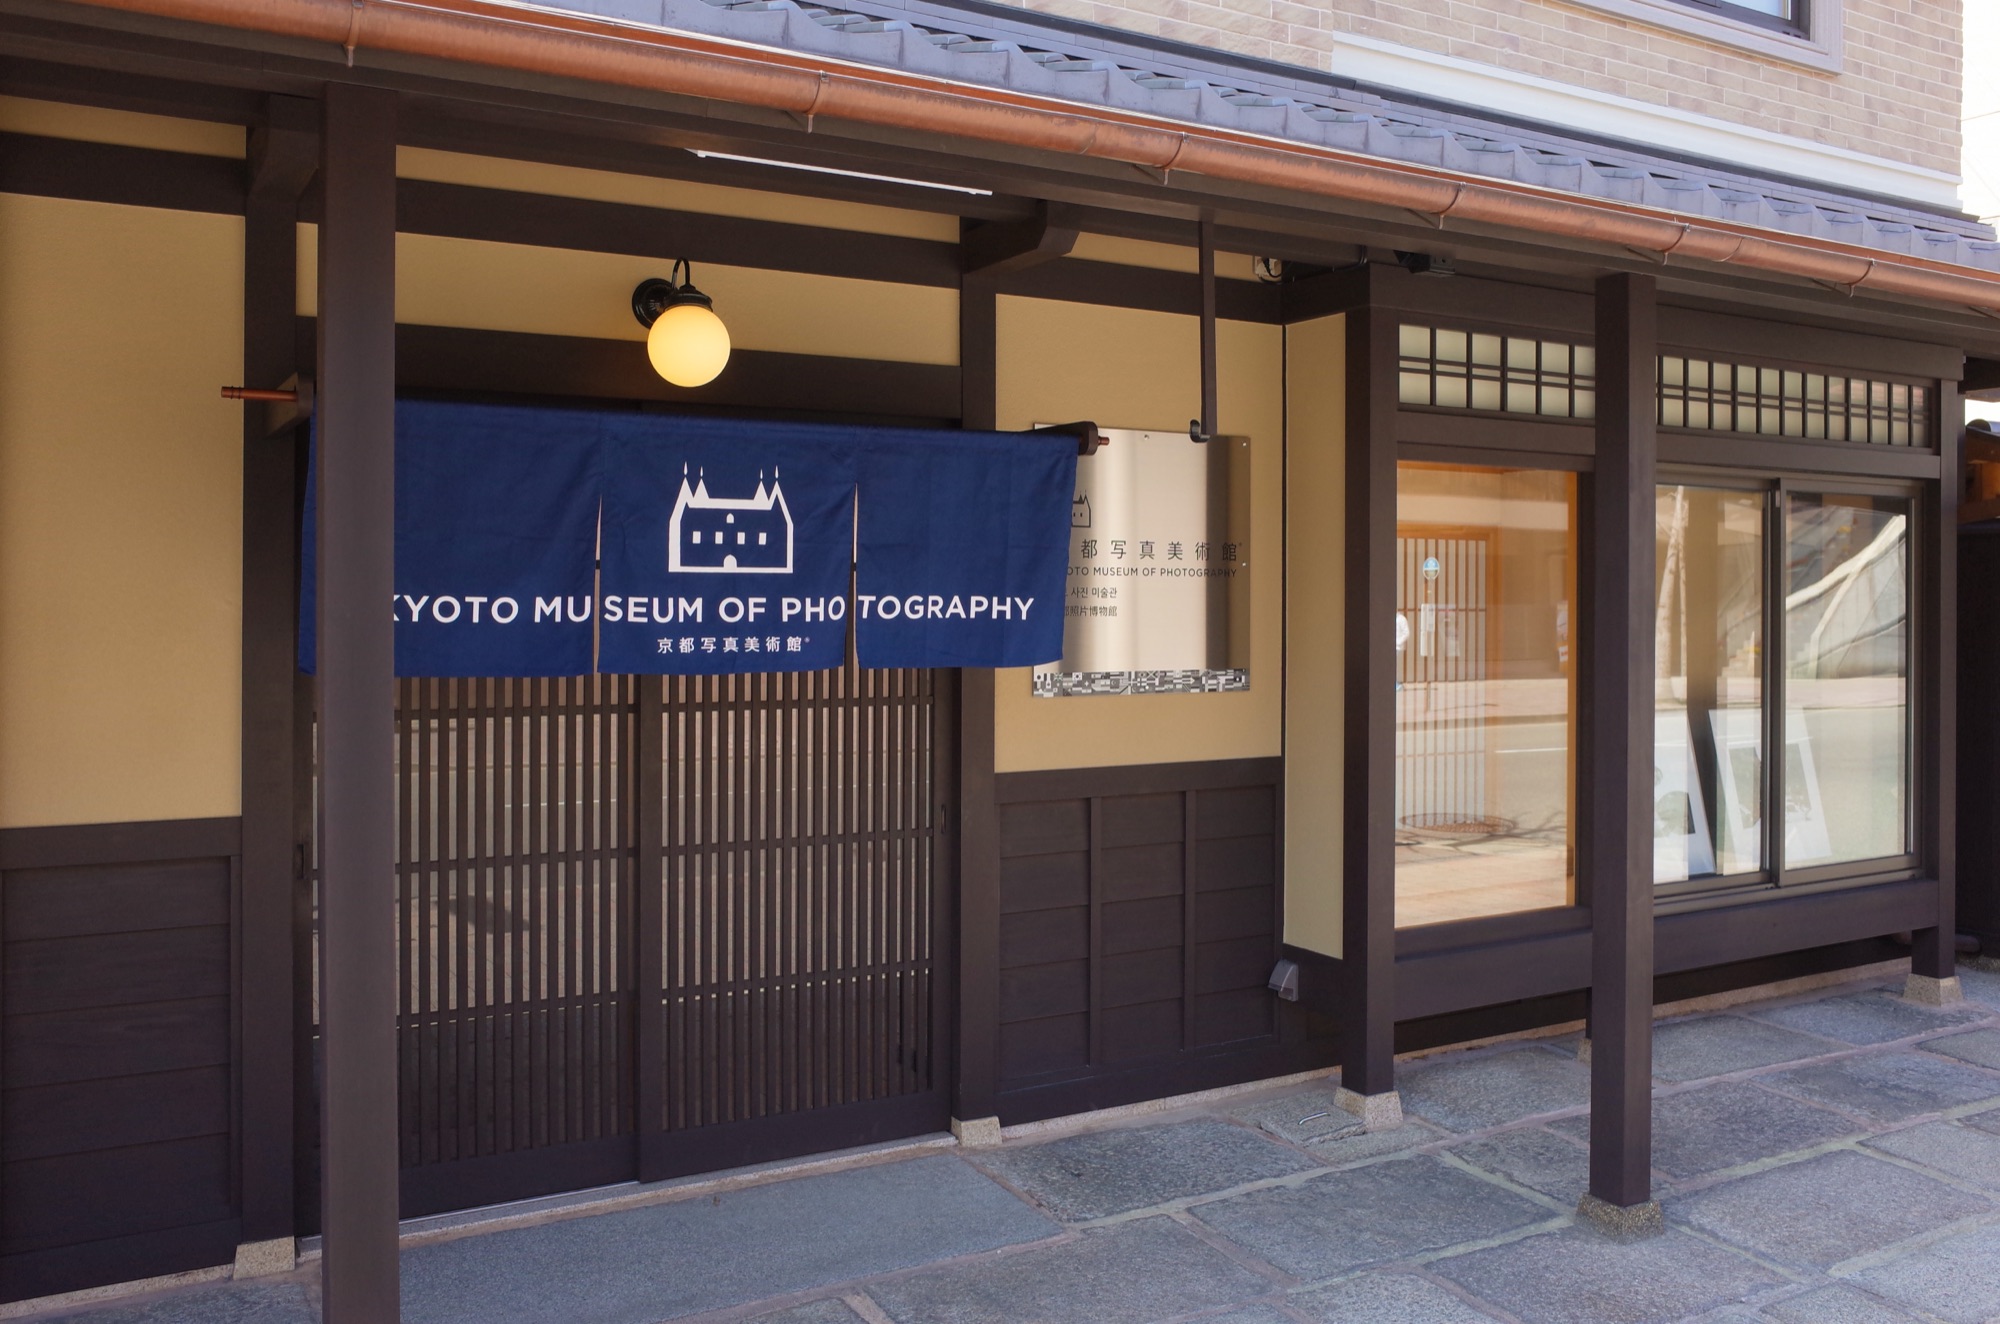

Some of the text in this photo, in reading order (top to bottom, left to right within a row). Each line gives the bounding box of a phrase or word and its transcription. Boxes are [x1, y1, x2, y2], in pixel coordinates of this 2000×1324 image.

[1080, 538, 1237, 562] 都写真美術館
[1067, 566, 1237, 578] OTO MUSEUM OF PHOTOGRAPHY
[1070, 586, 1118, 599] 사진 미술관
[718, 596, 767, 623] OF
[1065, 604, 1118, 617] 照片博物館
[656, 636, 802, 654] 京都写真美術館
